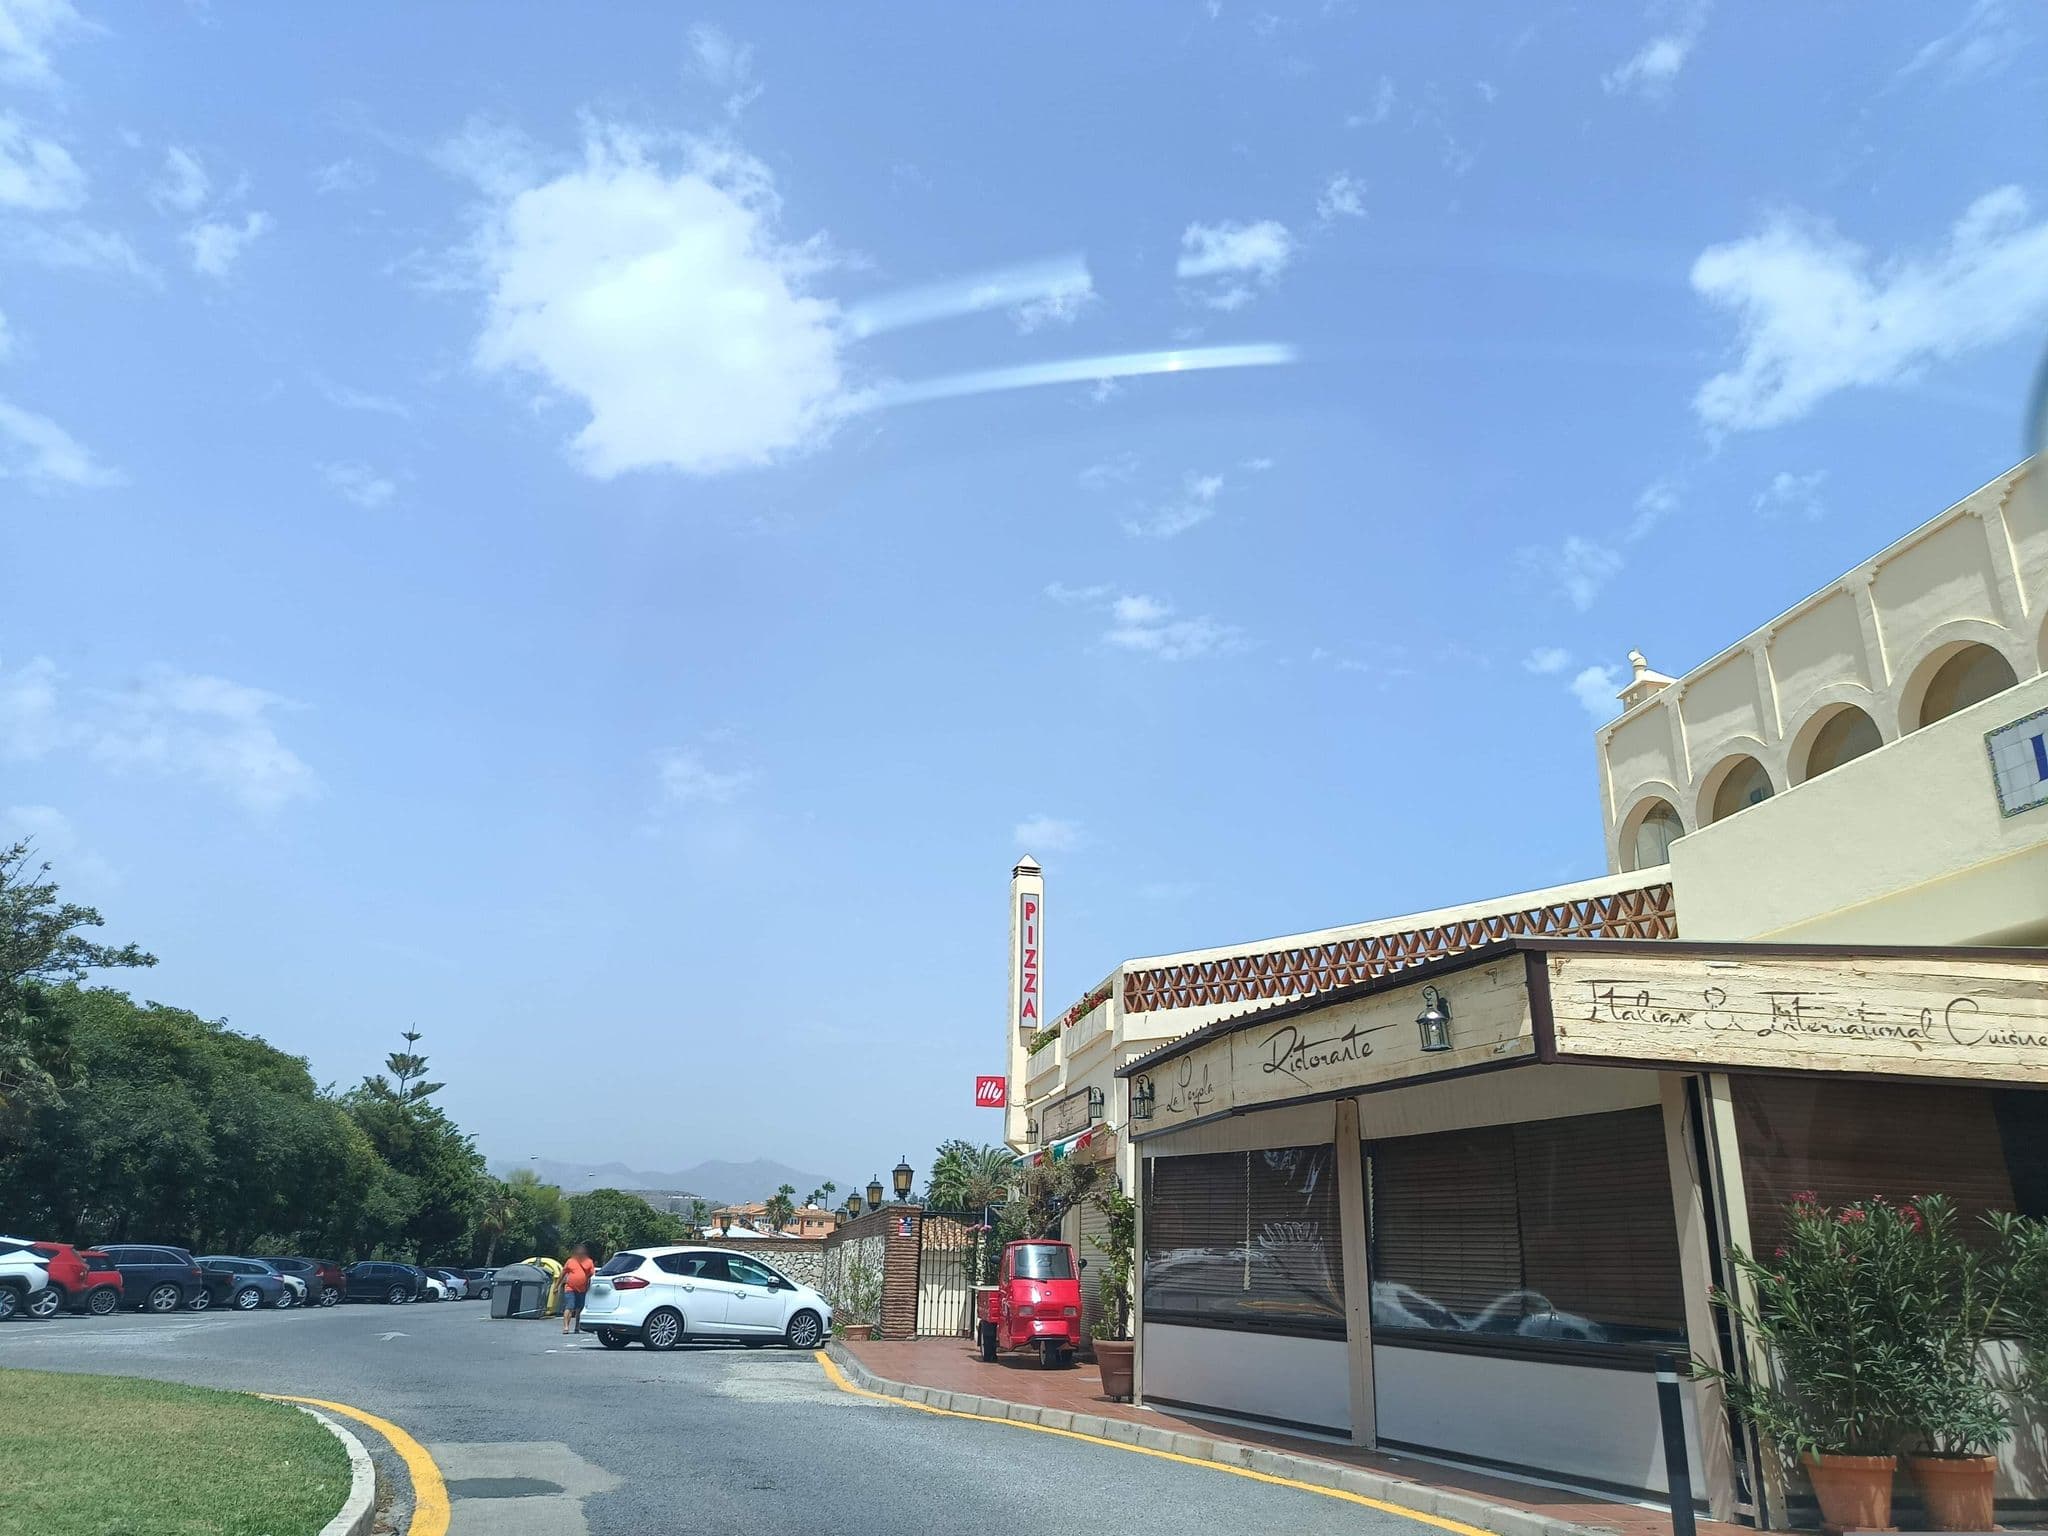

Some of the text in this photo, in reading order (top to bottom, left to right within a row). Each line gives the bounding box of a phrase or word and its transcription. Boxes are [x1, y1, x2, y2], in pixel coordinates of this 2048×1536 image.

[1023, 902, 1037, 1018] PIZZA
[1575, 979, 1692, 1025] Italian
[1754, 991, 1935, 1041] International
[1945, 997, 2048, 1047] Cuisine
[1258, 1025, 1397, 1088] Ristorante
[978, 1080, 1004, 1104] illy
